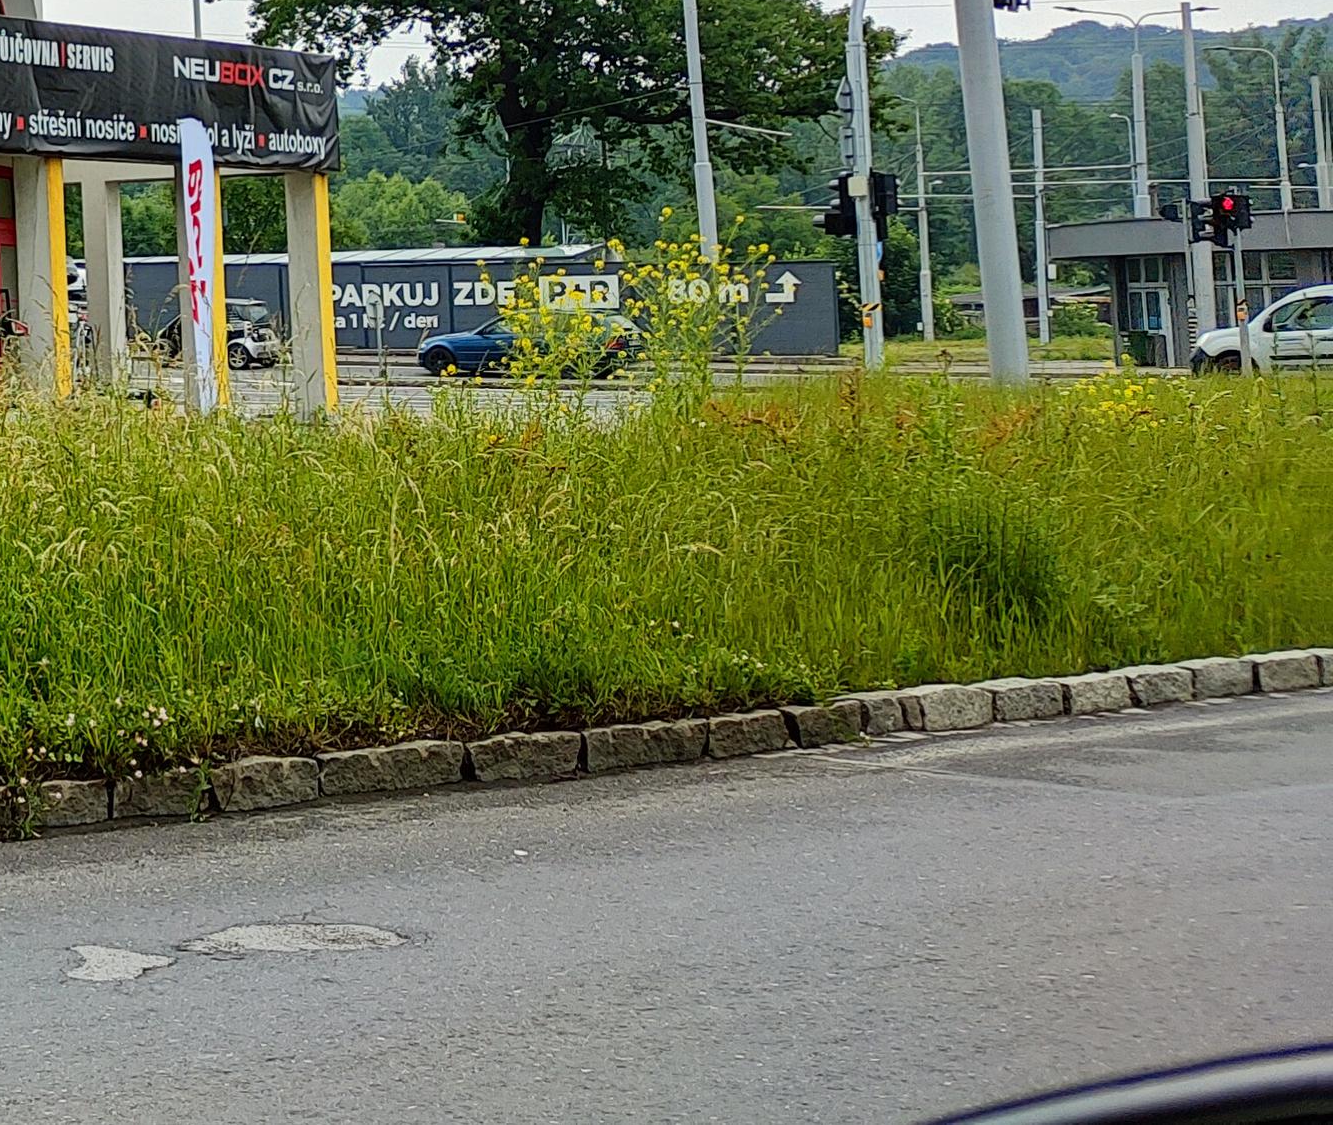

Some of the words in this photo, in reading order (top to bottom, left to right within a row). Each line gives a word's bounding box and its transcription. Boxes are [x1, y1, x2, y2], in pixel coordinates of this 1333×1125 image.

[67, 43, 115, 73] SERVIS
[173, 56, 265, 88] NEUBOX
[269, 68, 295, 91] CZ
[297, 81, 324, 95] s.r.o.
[29, 108, 82, 138] střešní
[86, 114, 136, 141] nosiče
[221, 128, 230, 147] a
[233, 123, 256, 155] lyží
[269, 128, 327, 160] autoboxy
[452, 280, 517, 306] ZDE
[719, 281, 750, 304] m
[334, 313, 347, 329] a
[349, 313, 358, 328] 1
[404, 312, 439, 329] den
